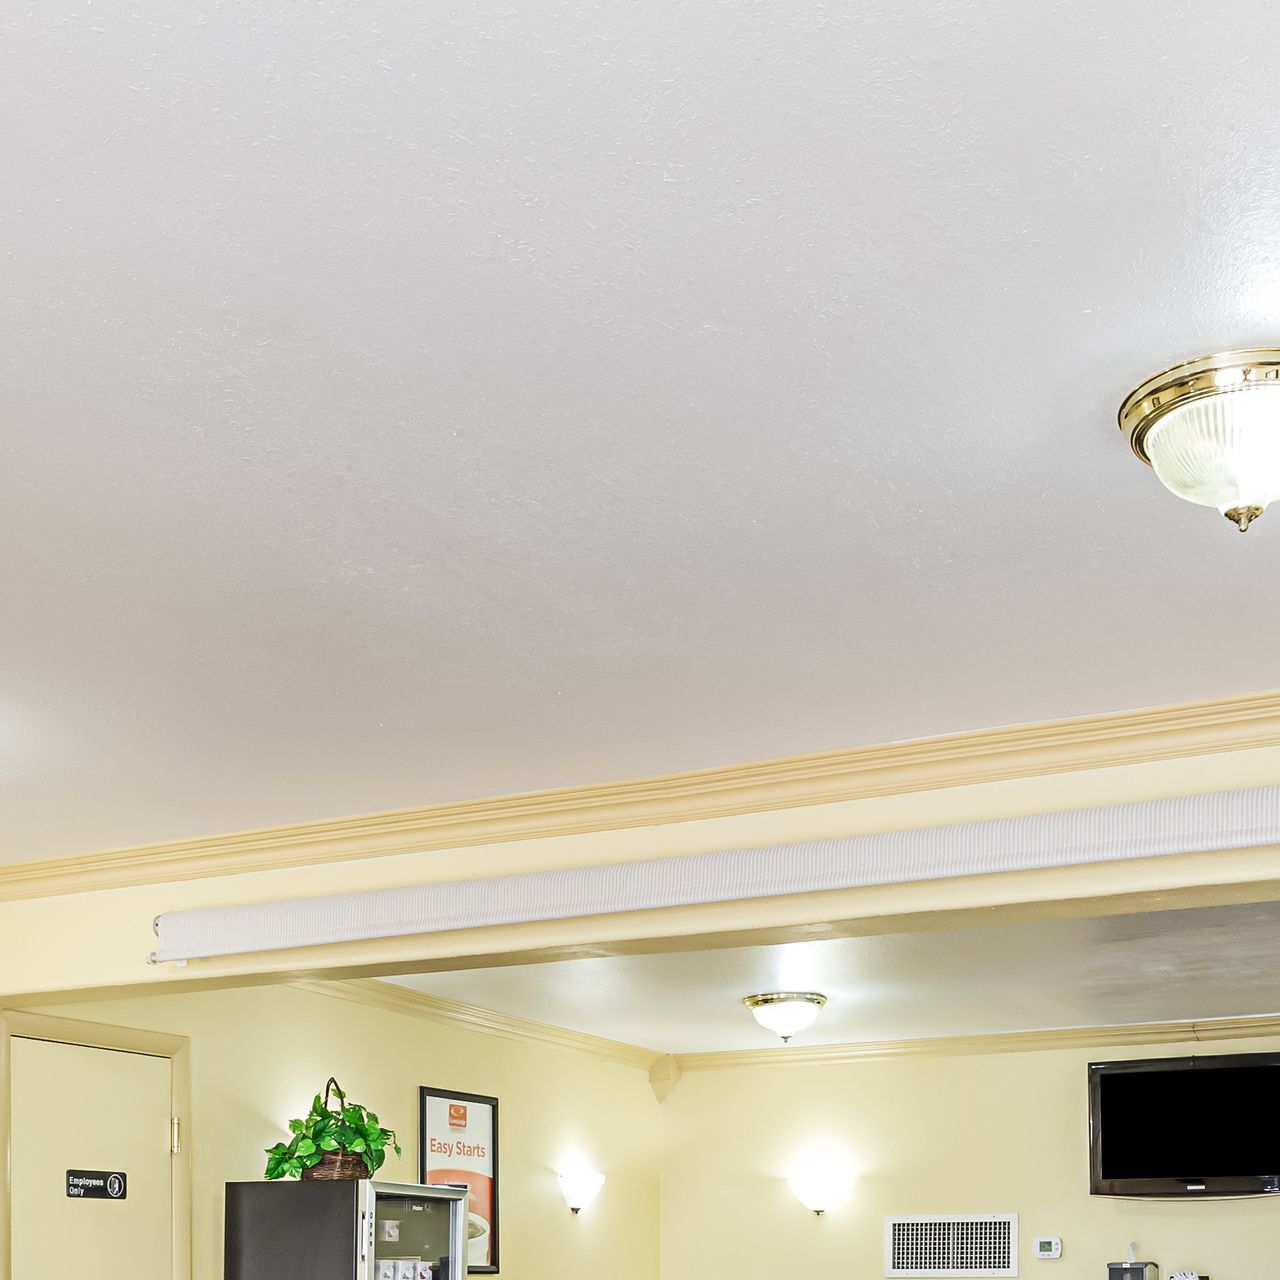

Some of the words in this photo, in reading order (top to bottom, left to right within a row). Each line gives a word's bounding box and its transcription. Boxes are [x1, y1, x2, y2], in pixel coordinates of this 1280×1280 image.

[429, 1138, 453, 1157] Easy
[456, 1141, 486, 1158] Starts
[69, 1176, 104, 1187] Employees
[69, 1186, 84, 1197] Only
